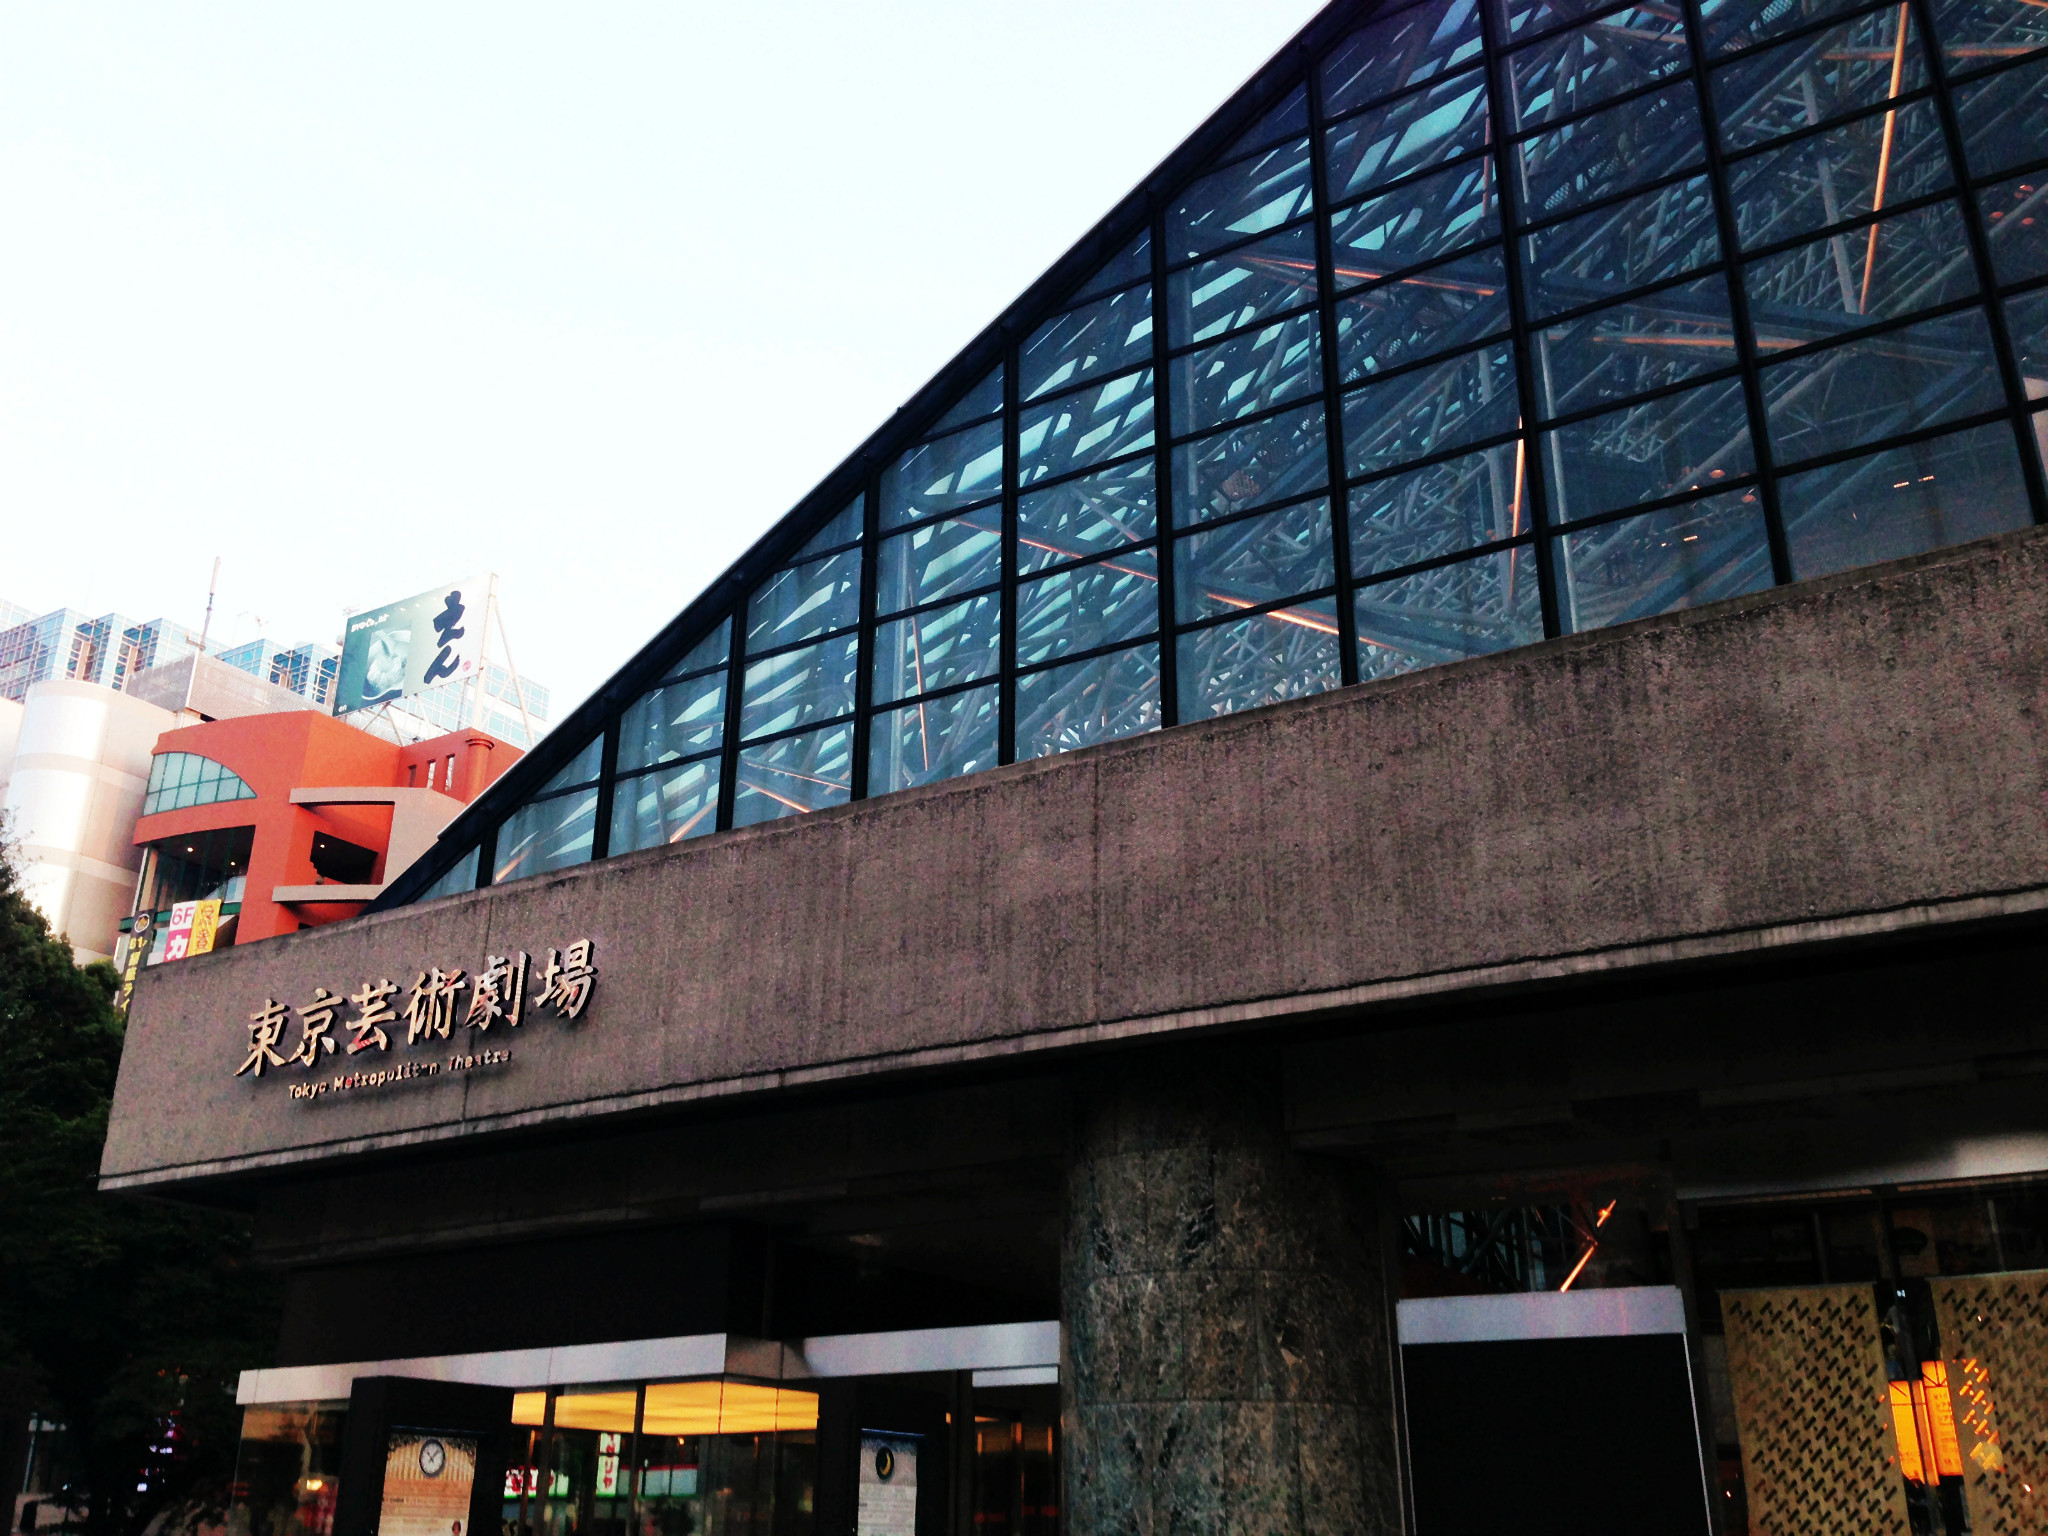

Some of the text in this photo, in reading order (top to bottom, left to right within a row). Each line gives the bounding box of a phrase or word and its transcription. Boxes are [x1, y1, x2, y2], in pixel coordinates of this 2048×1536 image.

[172, 906, 194, 926] 6F
[233, 938, 595, 1077] 東京芸術劇場
[288, 1048, 511, 1100] Tokyo Metropolitan Theatre
